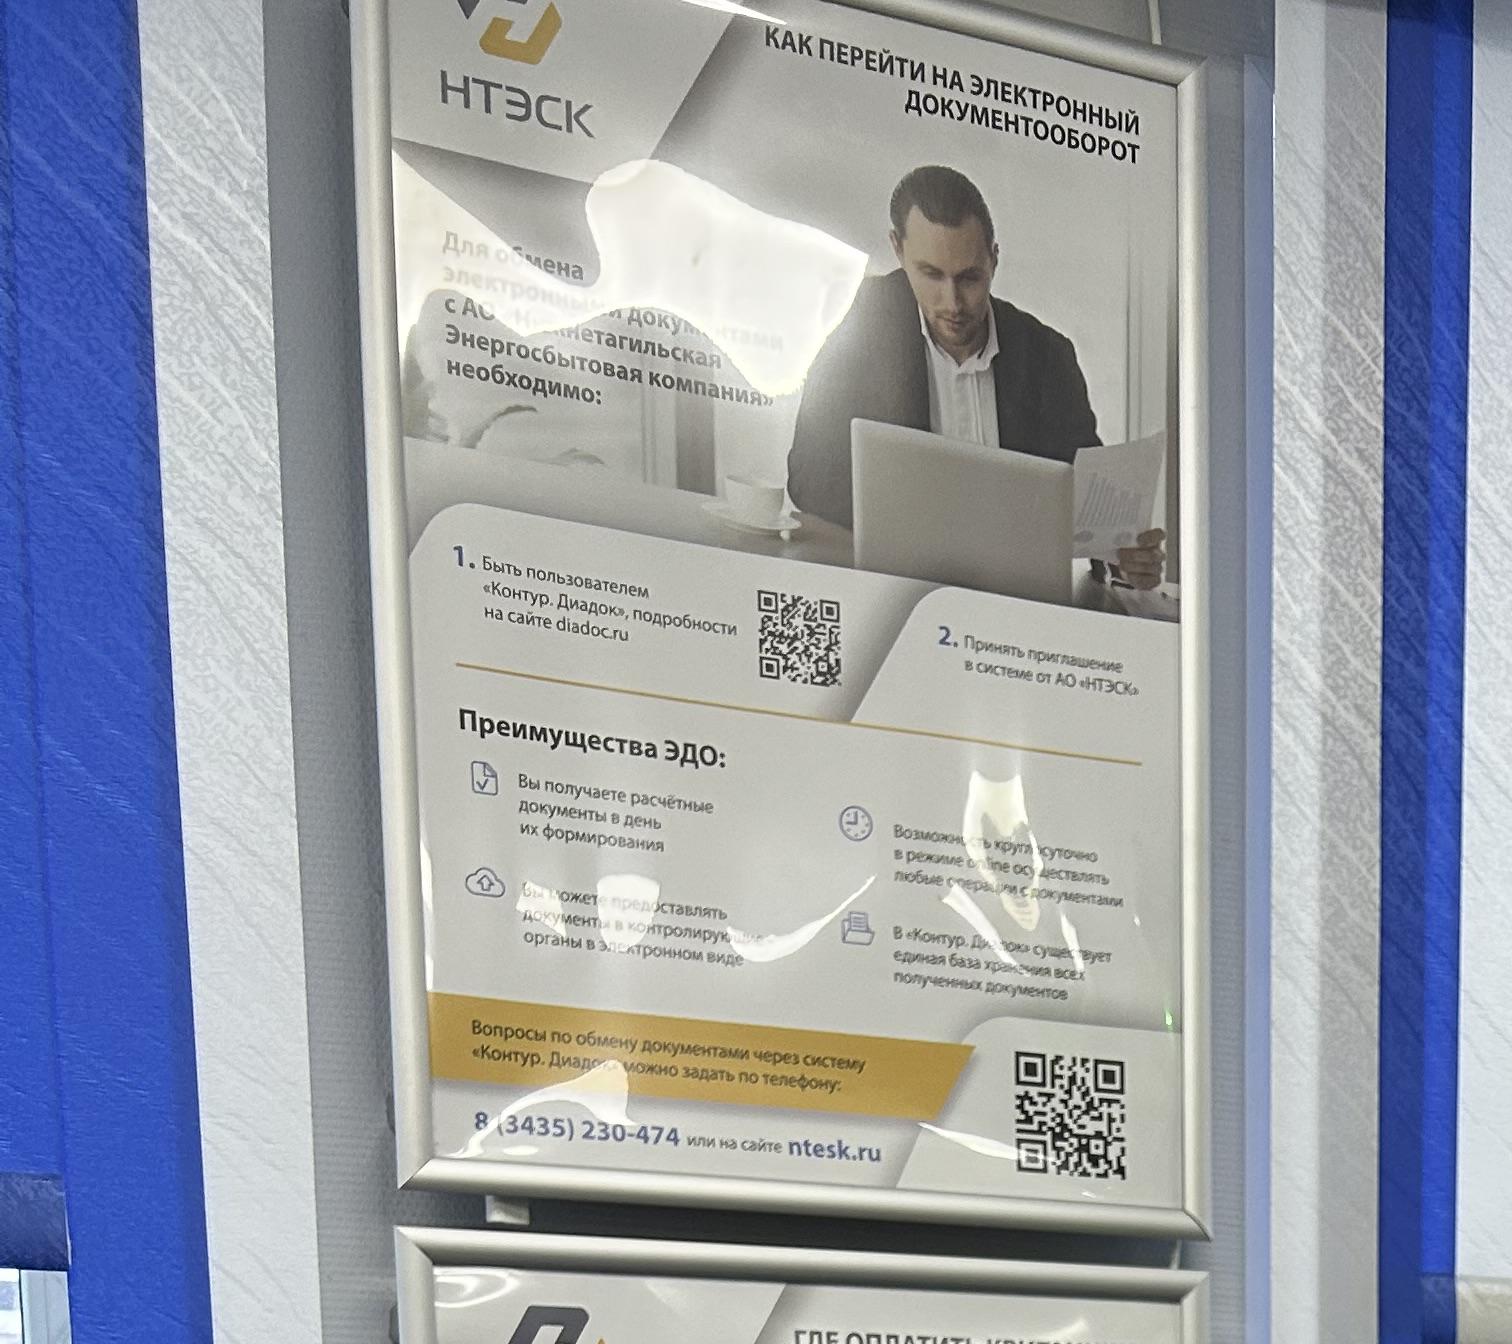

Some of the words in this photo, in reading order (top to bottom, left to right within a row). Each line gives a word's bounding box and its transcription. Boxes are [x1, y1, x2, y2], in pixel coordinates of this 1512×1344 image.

[440, 69, 596, 139] НТЭСК
[765, 25, 813, 57] КАК
[819, 38, 926, 83] ПЕРЕЙТИ
[932, 64, 964, 93] НА
[970, 74, 1140, 136] ЭЛЕКТРОННЫЙ
[905, 89, 1139, 164] ДОКУМЕНТООБОРОТ
[442, 231, 489, 259] Для
[444, 296, 456, 314] с
[445, 324, 643, 383] Энергосбытовая
[648, 369, 774, 407] компания»
[447, 358, 603, 405] необходимо:
[453, 546, 476, 569] 1.
[482, 555, 522, 577] Быть
[526, 567, 649, 599] пользователем
[483, 581, 554, 608] «Контур.
[557, 593, 629, 620] Диадок»,
[633, 608, 738, 636] подробности
[484, 606, 503, 621] на
[508, 610, 552, 628] сайте
[556, 616, 629, 642] diadoc.ru
[938, 626, 959, 648] 2.
[964, 634, 1025, 658] Принять
[1028, 648, 1124, 673] приглашение
[964, 660, 973, 671] в
[976, 662, 1033, 681] системе
[1036, 672, 1052, 684] от
[1055, 672, 1076, 688] АО
[1079, 676, 1139, 696] «НТЭСК»
[458, 708, 658, 760] Преимущества
[664, 740, 726, 769] ЭДО:
[518, 773, 540, 791] Вы
[544, 780, 627, 802] получаете
[630, 791, 714, 814] расчётные
[519, 800, 607, 823] документы
[611, 813, 620, 824] в
[624, 813, 662, 830] день
[520, 823, 538, 837] их
[542, 822, 664, 852] формирования
[524, 931, 582, 950] органы
[586, 939, 595, 950] в
[707, 950, 745, 968] виде
[893, 926, 903, 940] В
[893, 951, 946, 966] единая
[949, 953, 981, 970] база
[893, 971, 982, 991] полученных
[985, 981, 1068, 1001] документов
[472, 1020, 547, 1042] Вопросы
[551, 1030, 572, 1045] по
[576, 1031, 637, 1053] обмену
[642, 1039, 750, 1061] документами
[753, 1050, 800, 1067] через
[802, 1053, 866, 1074] систему
[472, 1044, 545, 1066] «Контур.
[623, 1060, 679, 1077] можно
[682, 1064, 735, 1083] задать
[739, 1073, 759, 1085] по
[762, 1073, 843, 1094] телефону:
[475, 1112, 488, 1131] 8
[497, 1115, 574, 1141] (3435)
[582, 1120, 680, 1147] 230-474
[687, 1135, 716, 1149] или
[719, 1138, 738, 1150] на
[741, 1138, 783, 1153] сайте
[788, 1139, 882, 1162] ntesk.ru
